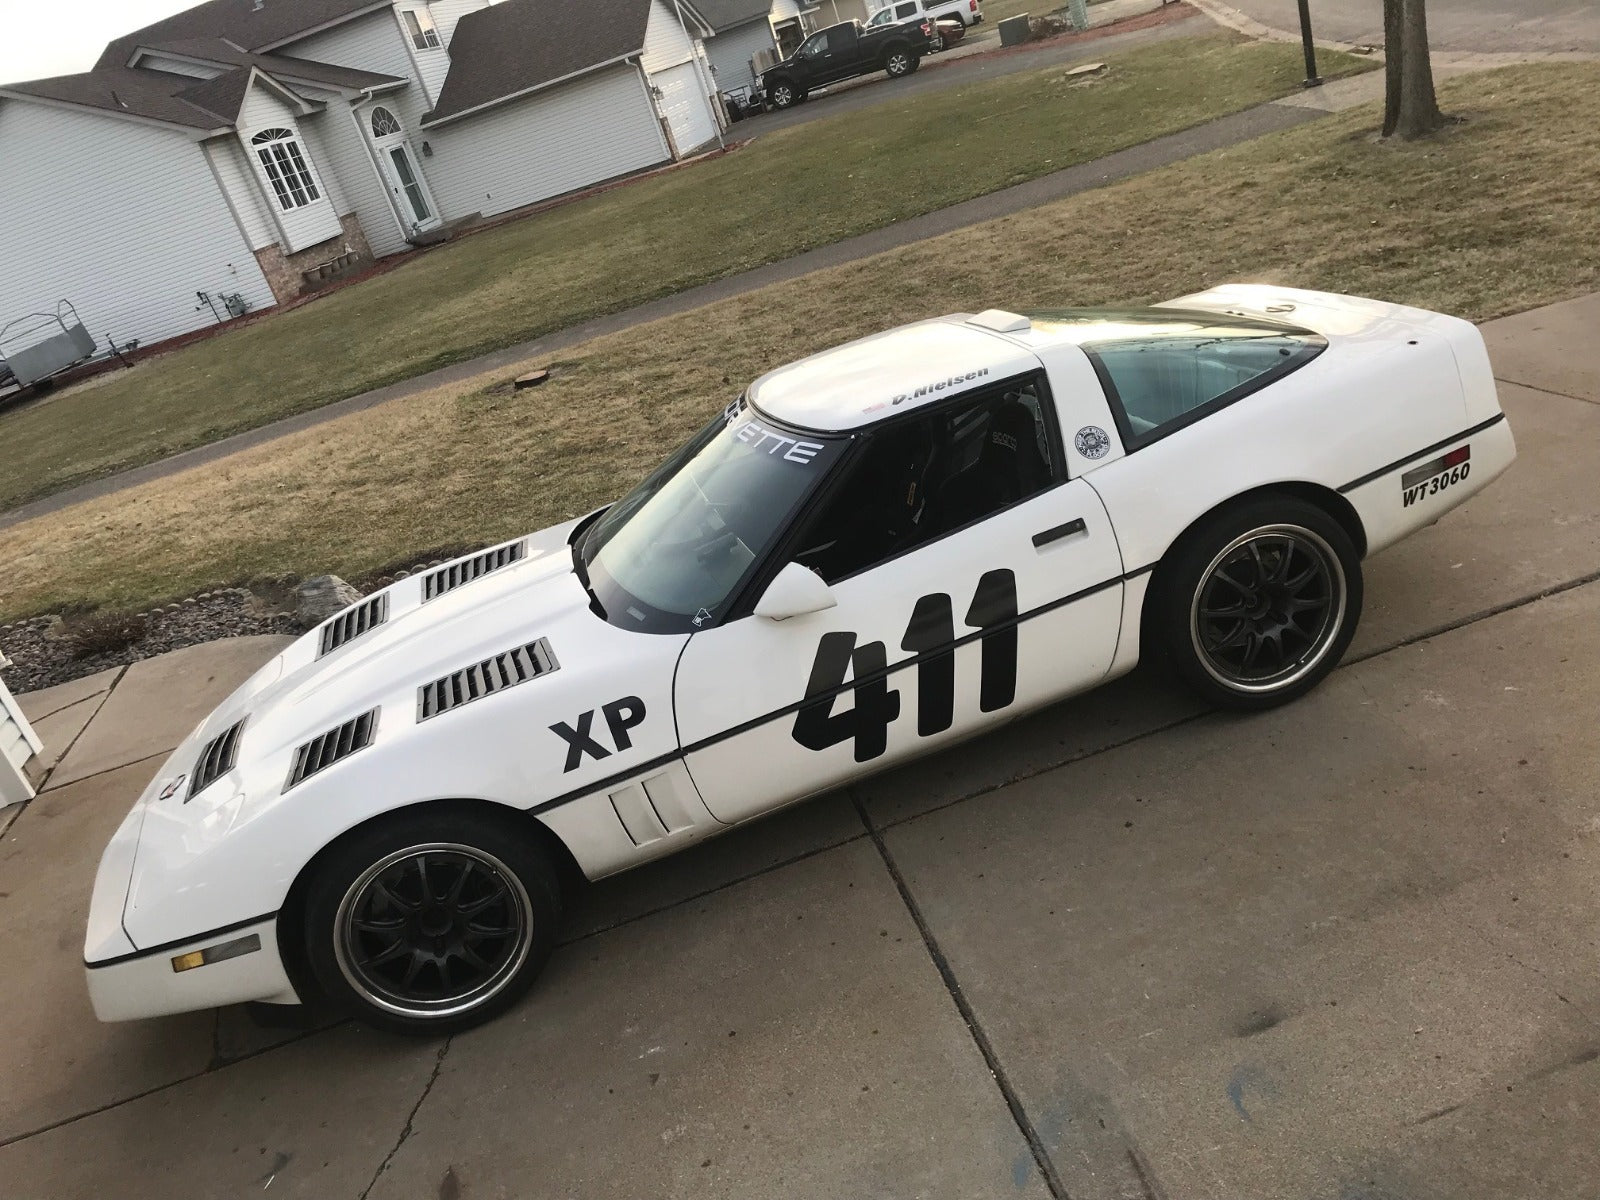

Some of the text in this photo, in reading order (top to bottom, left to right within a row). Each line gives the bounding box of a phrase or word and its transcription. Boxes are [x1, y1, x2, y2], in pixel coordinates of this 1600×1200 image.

[892, 367, 989, 406] D.Nielsen
[1403, 462, 1471, 508] WT3060
[791, 568, 1018, 763] 411
[547, 695, 647, 774] XP
